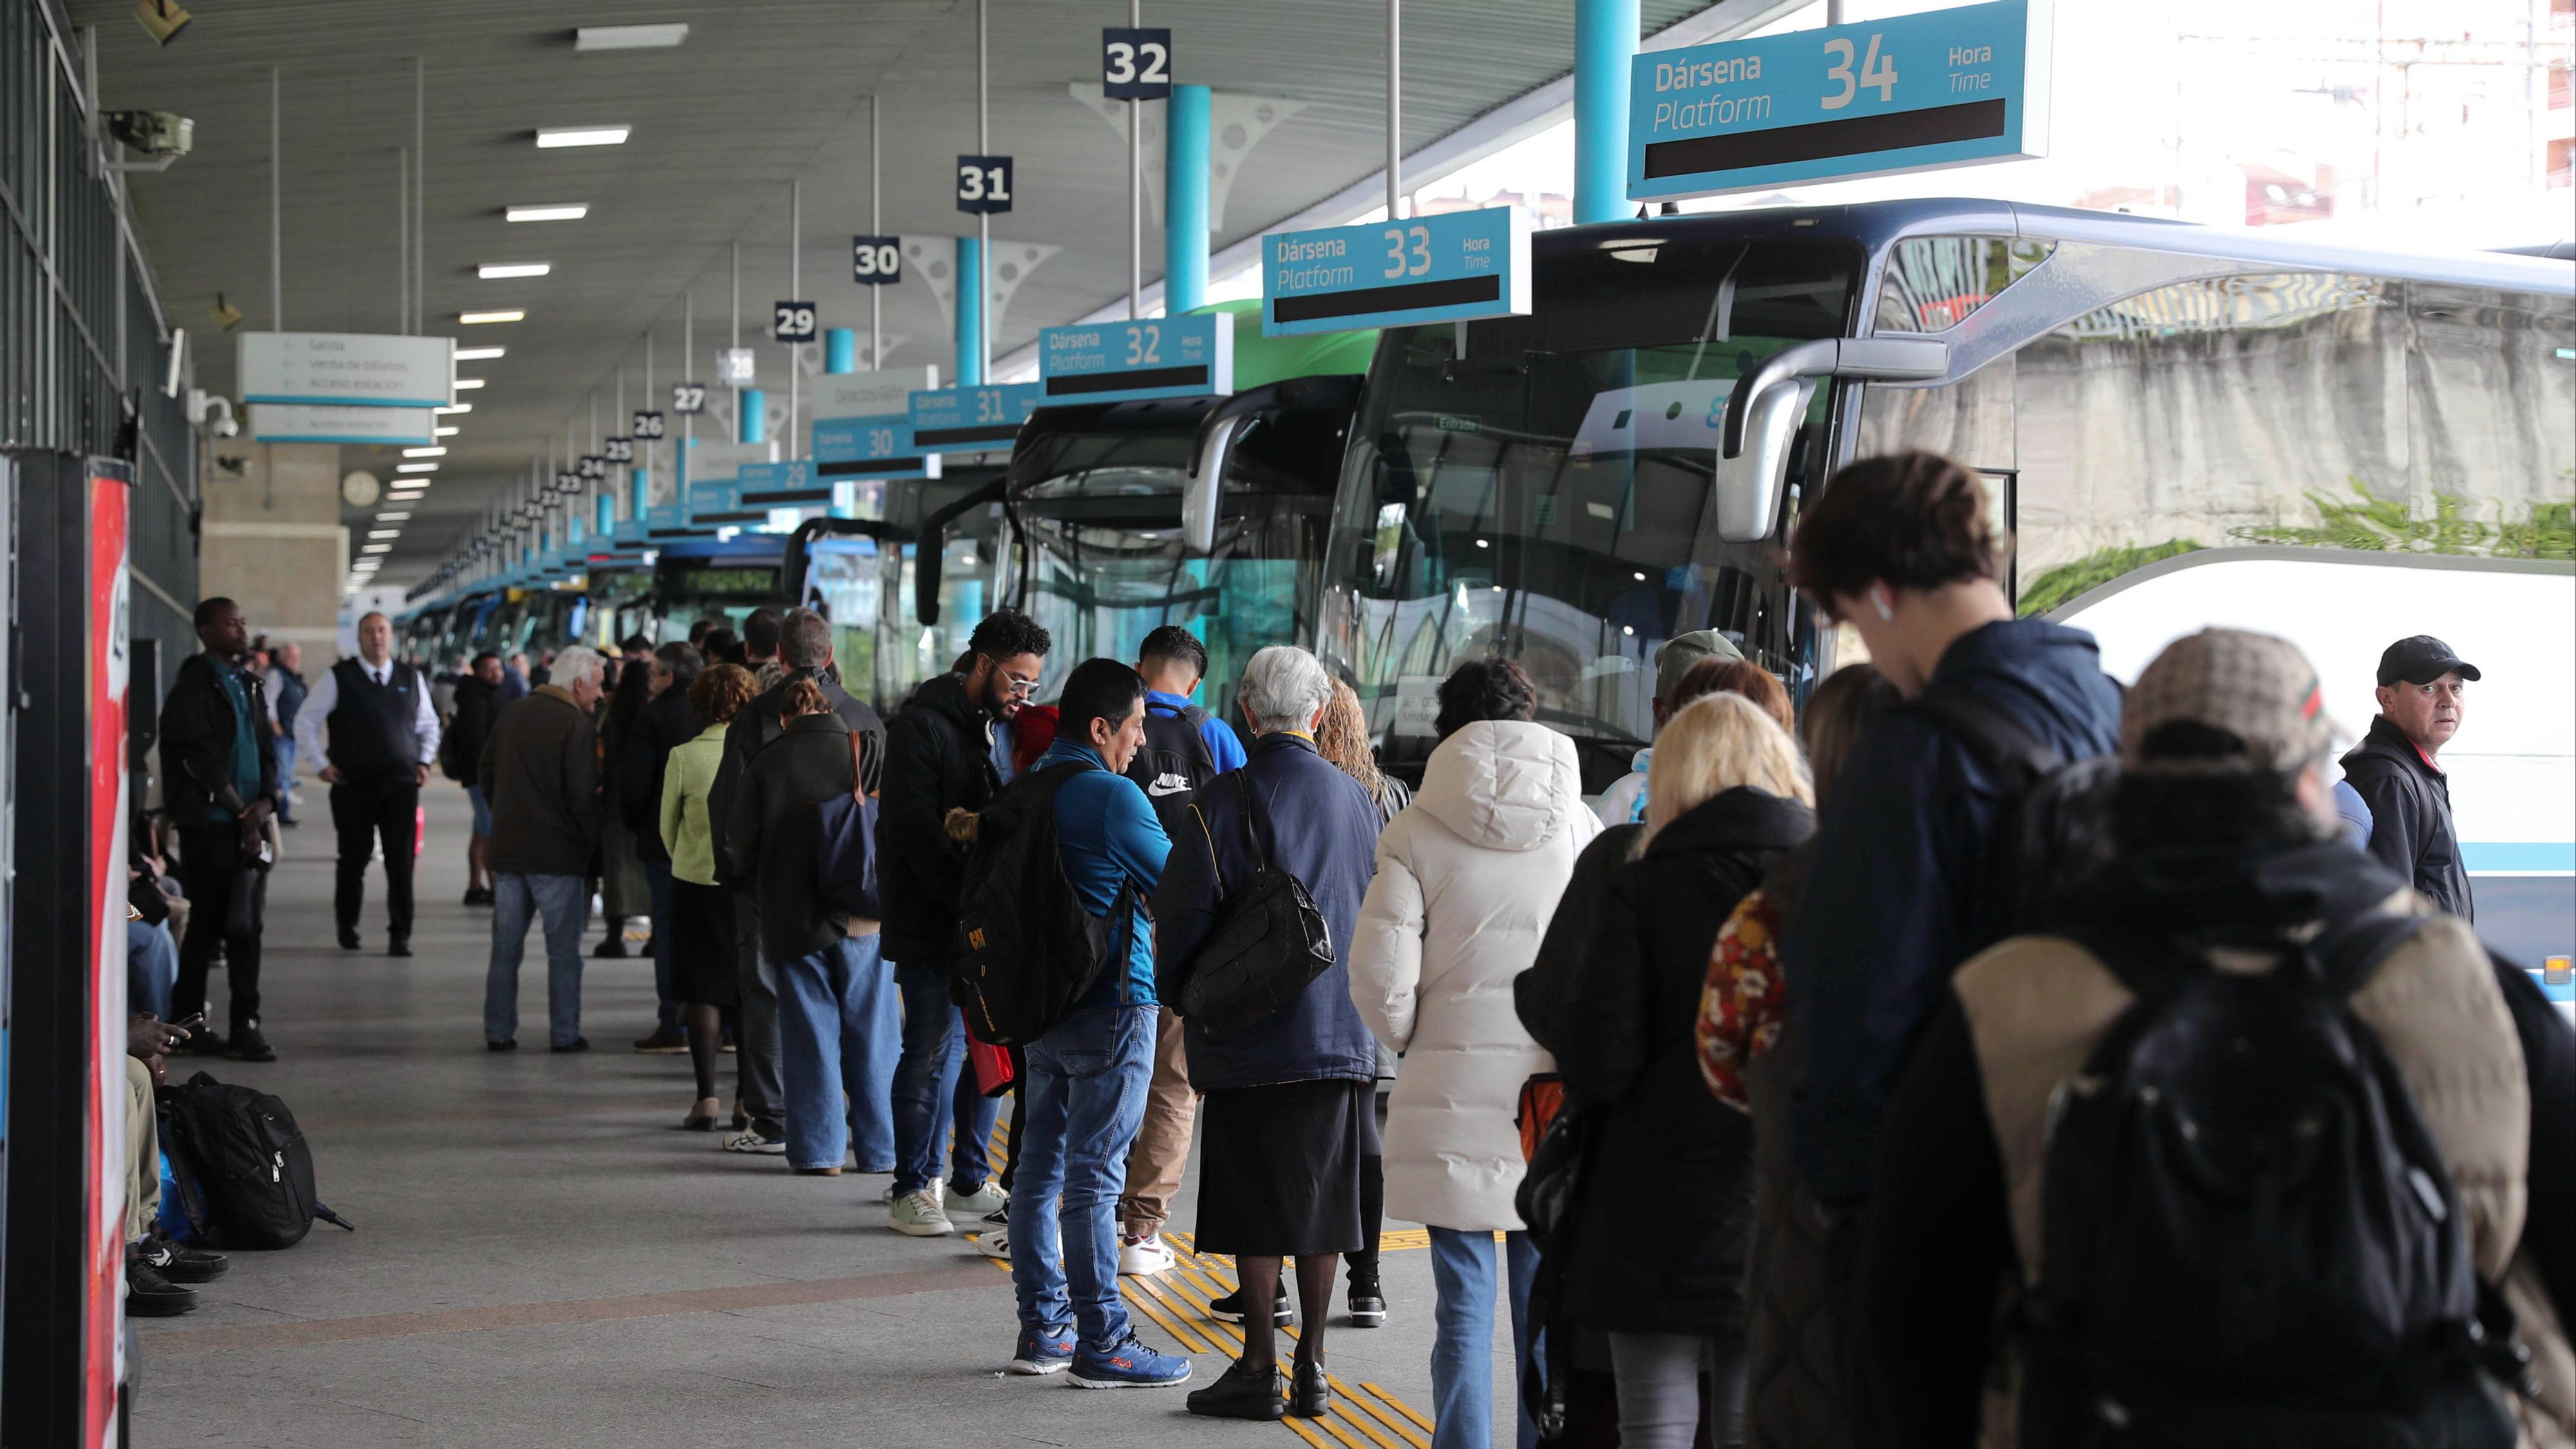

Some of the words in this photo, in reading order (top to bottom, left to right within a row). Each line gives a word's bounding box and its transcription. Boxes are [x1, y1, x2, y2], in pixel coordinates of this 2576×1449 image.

[1106, 43, 1168, 84] 32
[1949, 44, 1992, 67] Hora
[1656, 55, 1761, 92] Dársena
[1821, 33, 1898, 110] 34
[1949, 71, 1991, 93] Time
[1654, 93, 1771, 132] Platform
[960, 167, 1009, 200] 31
[1278, 238, 1345, 263] Dársena
[1384, 226, 1432, 279] 33
[1463, 238, 1490, 252] Hora
[855, 245, 899, 275] 30
[1464, 255, 1490, 269] Time
[1278, 265, 1353, 291] Platform
[777, 308, 814, 336] 29
[1050, 332, 1099, 349] Dársena
[1126, 325, 1160, 365] 32
[1182, 336, 1202, 346] Hora
[1050, 352, 1104, 371] Platform
[674, 389, 705, 410] 27
[977, 391, 1005, 422] 31
[635, 417, 663, 435] 26
[607, 441, 632, 459] 25
[869, 430, 893, 456] 30
[1157, 772, 1188, 788] NIKE
[969, 927, 987, 950] CAT
[1109, 1356, 1132, 1370] FILA
